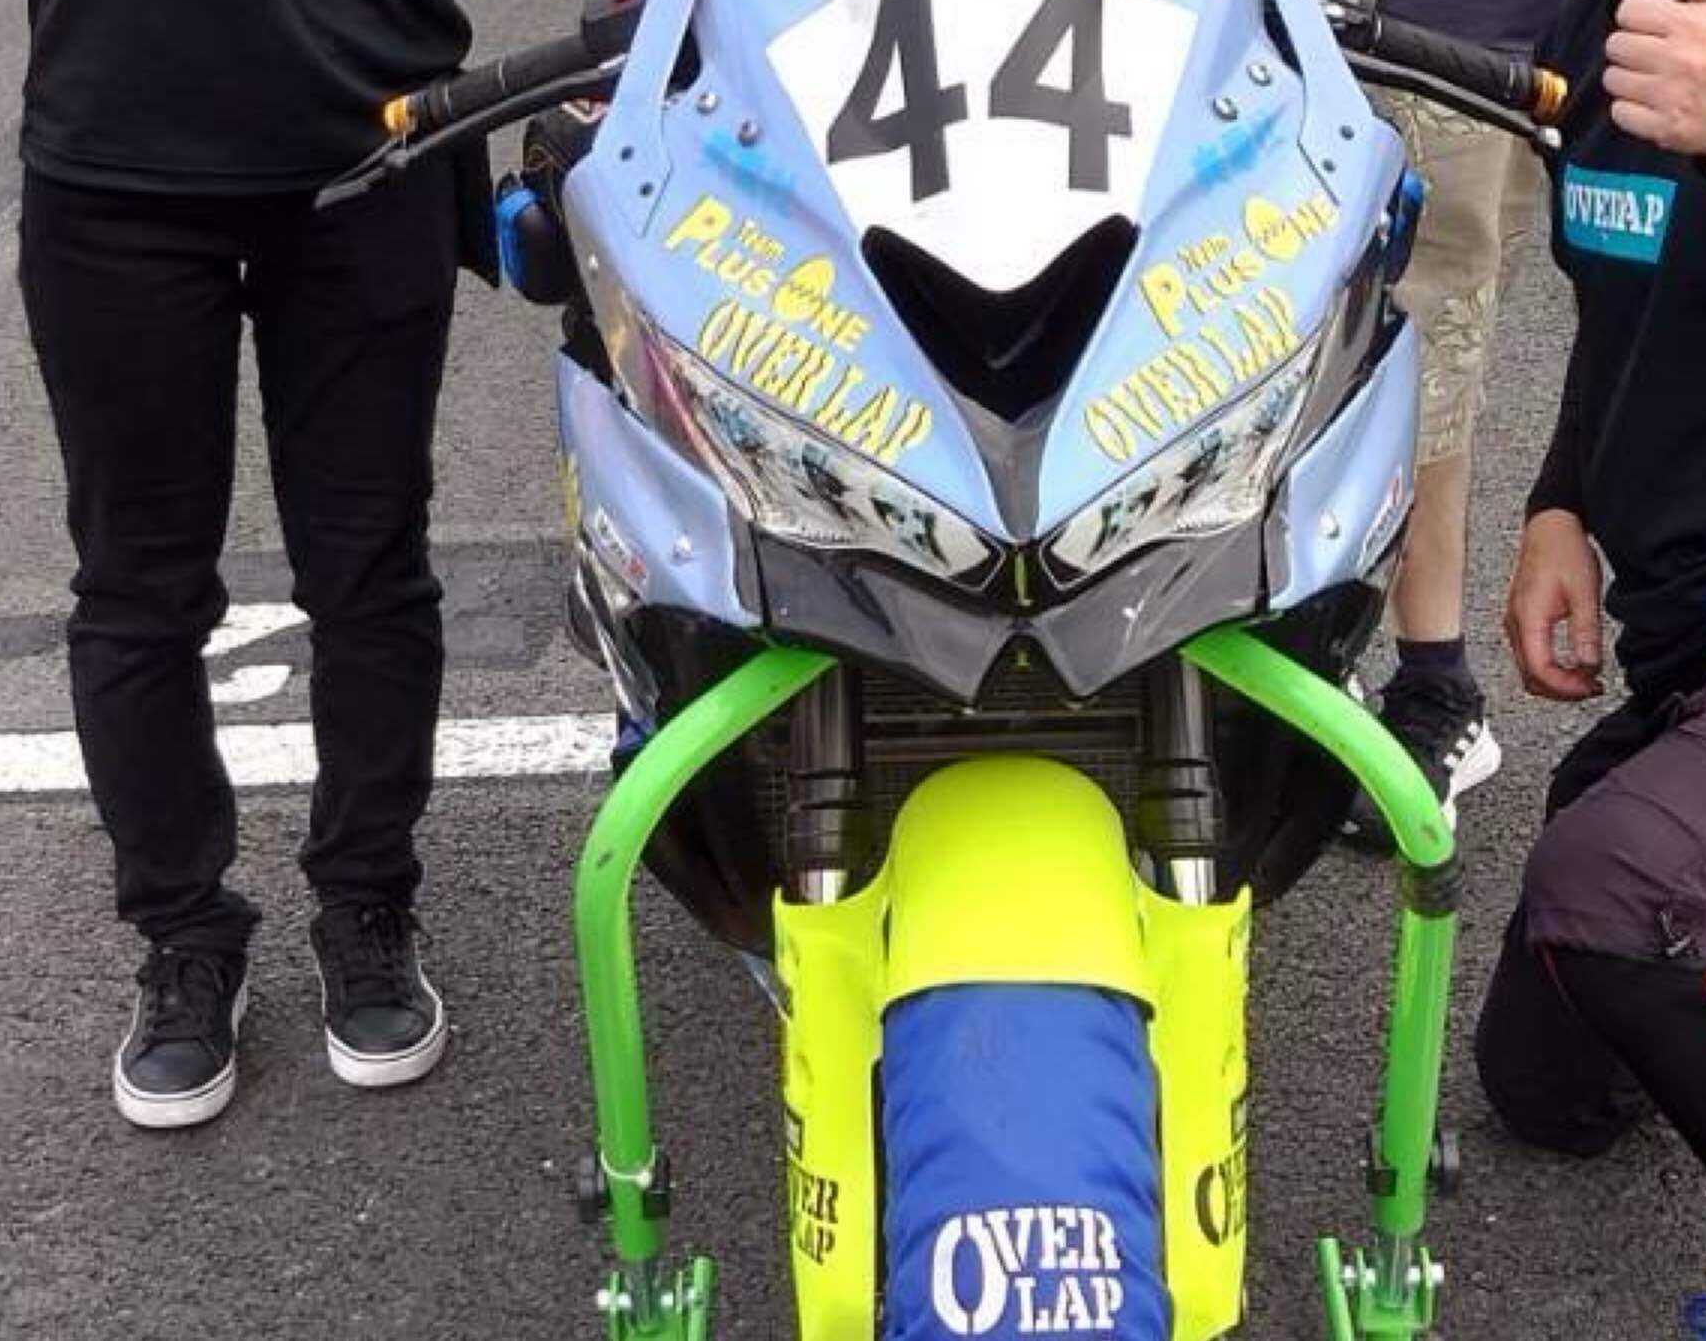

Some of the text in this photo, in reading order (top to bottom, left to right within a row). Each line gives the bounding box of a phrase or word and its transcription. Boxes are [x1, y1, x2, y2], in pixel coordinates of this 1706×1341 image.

[698, 297, 933, 465] OVER LAP
[1083, 343, 1231, 463] OVER
[933, 1206, 1122, 1335] OVER
[1014, 1276, 1124, 1333] LAP
